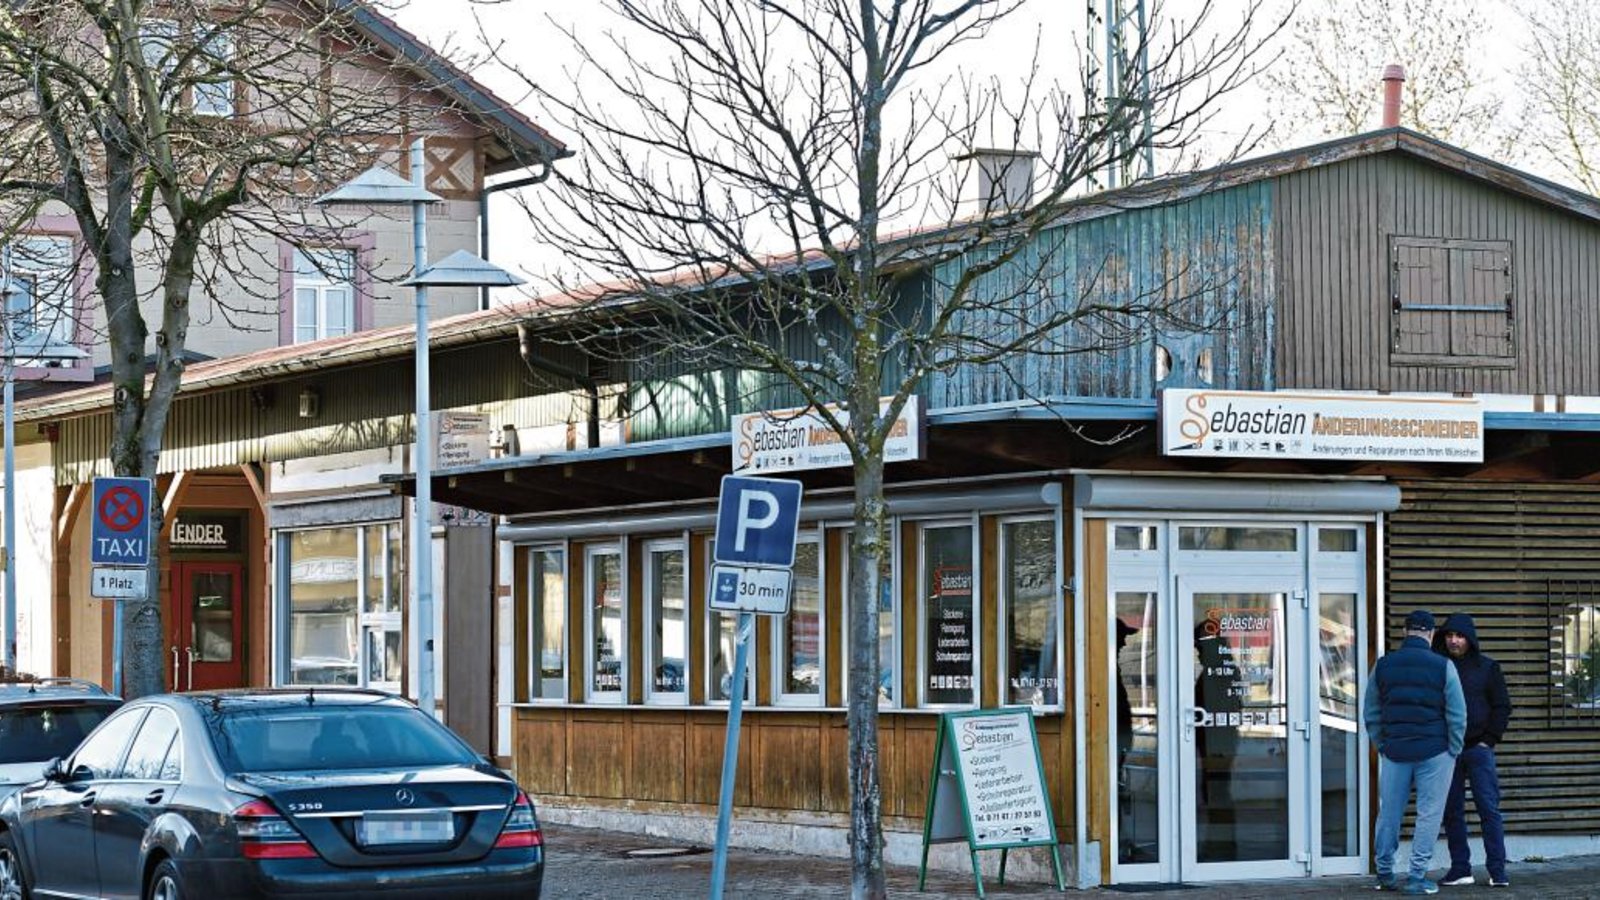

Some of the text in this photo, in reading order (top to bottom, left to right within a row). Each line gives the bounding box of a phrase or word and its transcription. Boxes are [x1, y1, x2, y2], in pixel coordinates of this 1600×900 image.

[1180, 393, 1479, 439] Sebastian ÄNDERUNGSSCHNEIDER
[1312, 443, 1353, 456] Änderungen
[1354, 446, 1366, 454] und
[1368, 445, 1408, 457] Reparaturen
[735, 489, 779, 552] P
[97, 538, 143, 557] TAXI
[100, 577, 132, 589] 1 Platz
[740, 582, 784, 597] 30 min
